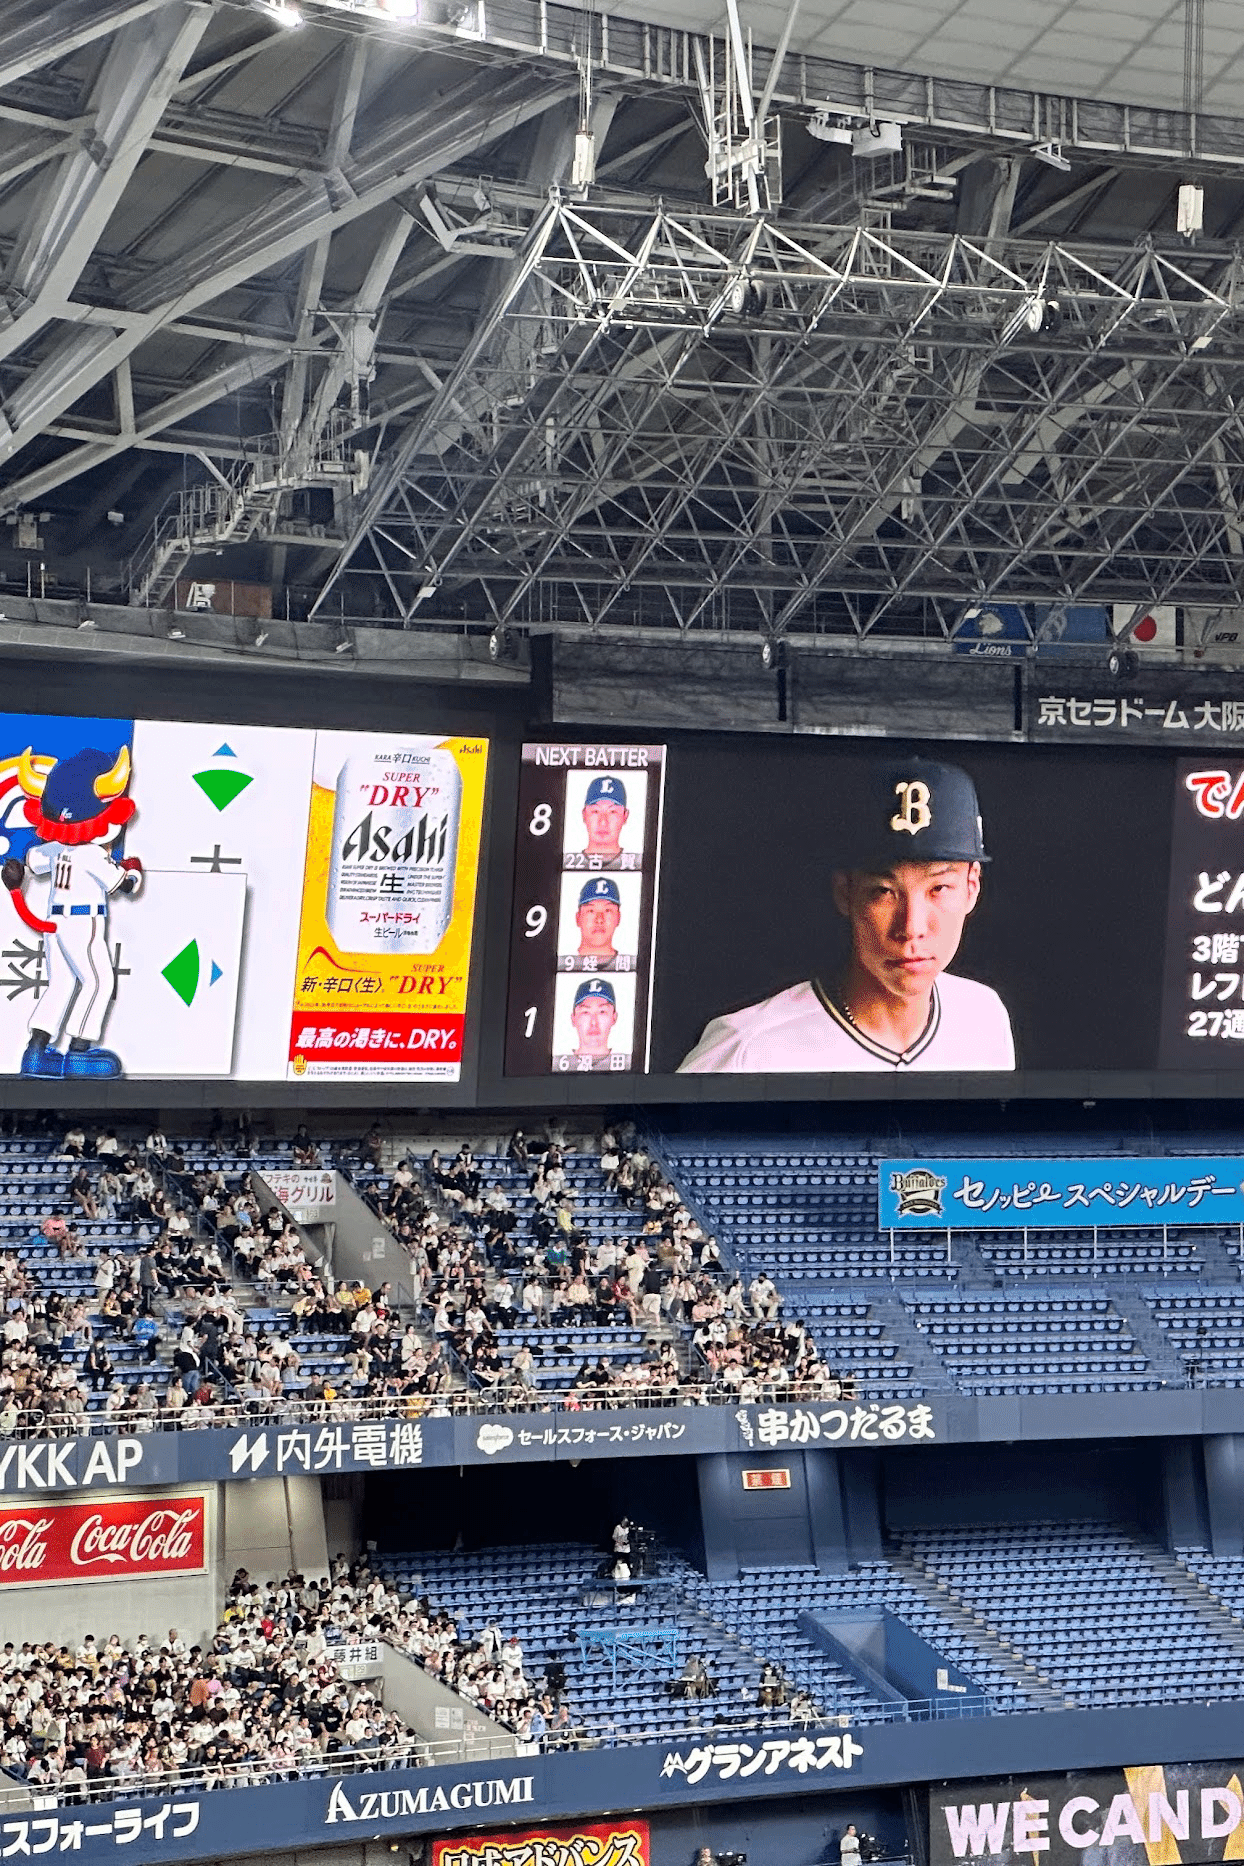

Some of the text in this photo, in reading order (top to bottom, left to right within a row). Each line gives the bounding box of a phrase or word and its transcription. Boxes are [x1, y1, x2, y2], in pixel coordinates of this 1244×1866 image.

[969, 642, 1011, 656] Lions
[459, 744, 483, 755] Asahi
[535, 746, 649, 767] NEXT BATTER
[382, 771, 420, 782] SUPER
[529, 803, 552, 836] 8
[890, 781, 931, 835] B
[342, 810, 448, 864] Asahi
[565, 854, 585, 868] 22
[379, 873, 405, 894] 生
[359, 912, 421, 924] スーパードライ
[524, 905, 548, 938] 9
[411, 964, 445, 973] SUPER
[564, 956, 575, 971] 9
[524, 1006, 538, 1038] 1
[559, 1055, 569, 1070] 6
[518, 1421, 686, 1446] セールスフォース・ジャパン
[758, 1404, 936, 1446] 串かつだるま
[82, 1438, 144, 1485] AP
[277, 1423, 423, 1471] 内外電機
[70, 1508, 200, 1566] Coca-Cola
[684, 1733, 864, 1784] グランアネスト
[325, 1776, 535, 1824] AZUMAGUMI
[944, 1799, 1050, 1857] WE
[1058, 1789, 1189, 1849] CAN
